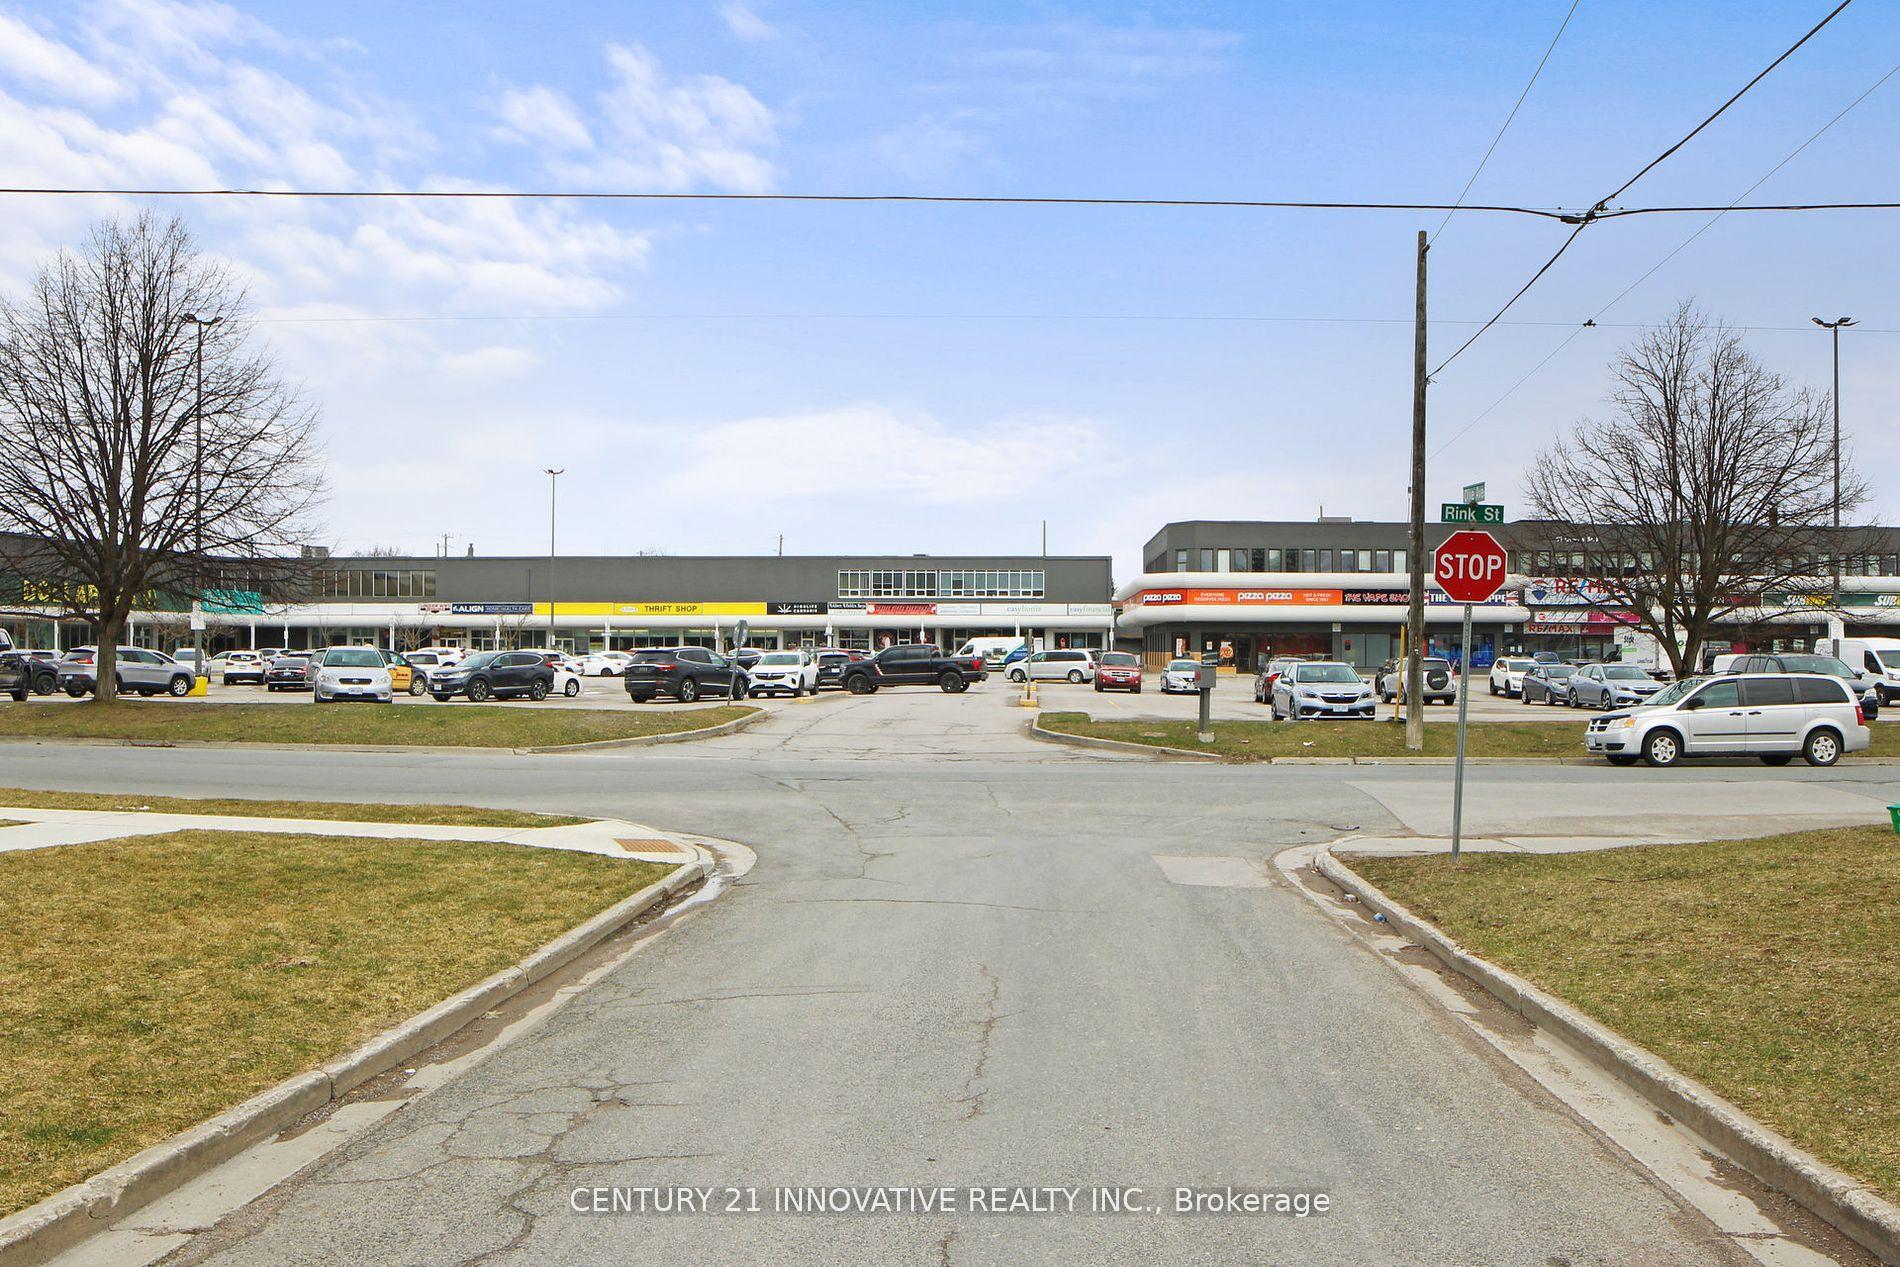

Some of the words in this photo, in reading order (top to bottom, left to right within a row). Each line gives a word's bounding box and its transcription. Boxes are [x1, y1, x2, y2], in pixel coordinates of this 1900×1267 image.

[1445, 506, 1476, 521] Rink
[1484, 507, 1500, 521] St
[1439, 553, 1502, 581] STOP
[1143, 593, 1162, 603] pizza
[1162, 593, 1182, 603] pizza
[1237, 592, 1264, 602] pizza
[1265, 592, 1293, 602] pizza
[1344, 592, 1362, 603] THE
[1362, 592, 1389, 603] VAPE
[1388, 592, 1411, 603] SHO
[1430, 593, 1448, 602] THE
[459, 605, 484, 613] ALIGN
[644, 605, 672, 613] THRIFT
[675, 605, 697, 613] SHOP
[1528, 624, 1574, 633] RE/MAX
